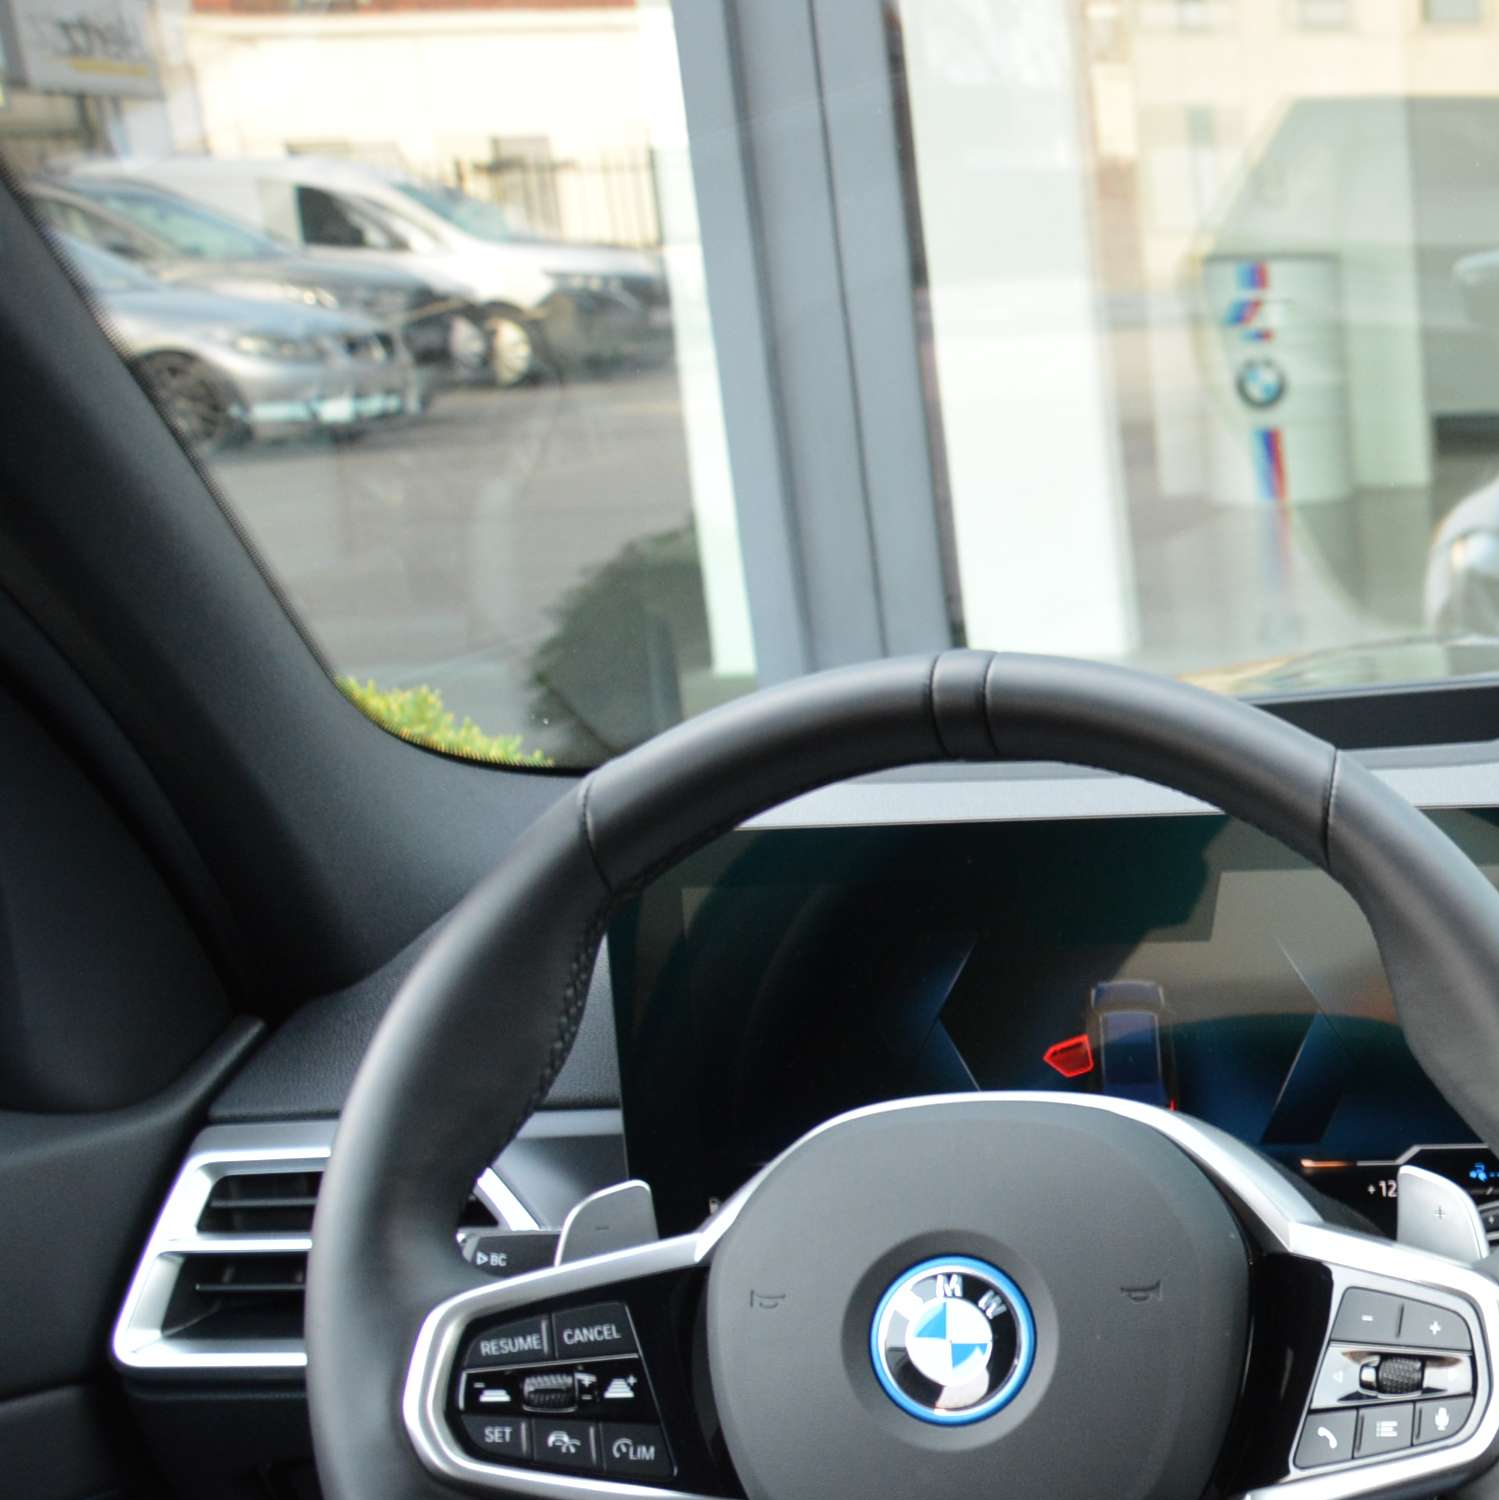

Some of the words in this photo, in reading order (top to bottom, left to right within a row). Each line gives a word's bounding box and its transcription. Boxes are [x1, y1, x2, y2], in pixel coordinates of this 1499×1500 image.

[489, 1253, 507, 1267] BC
[563, 1324, 622, 1346] CANCEL
[480, 1333, 543, 1356] RESUME
[484, 1427, 512, 1443] SET
[629, 1446, 655, 1461] LIM
